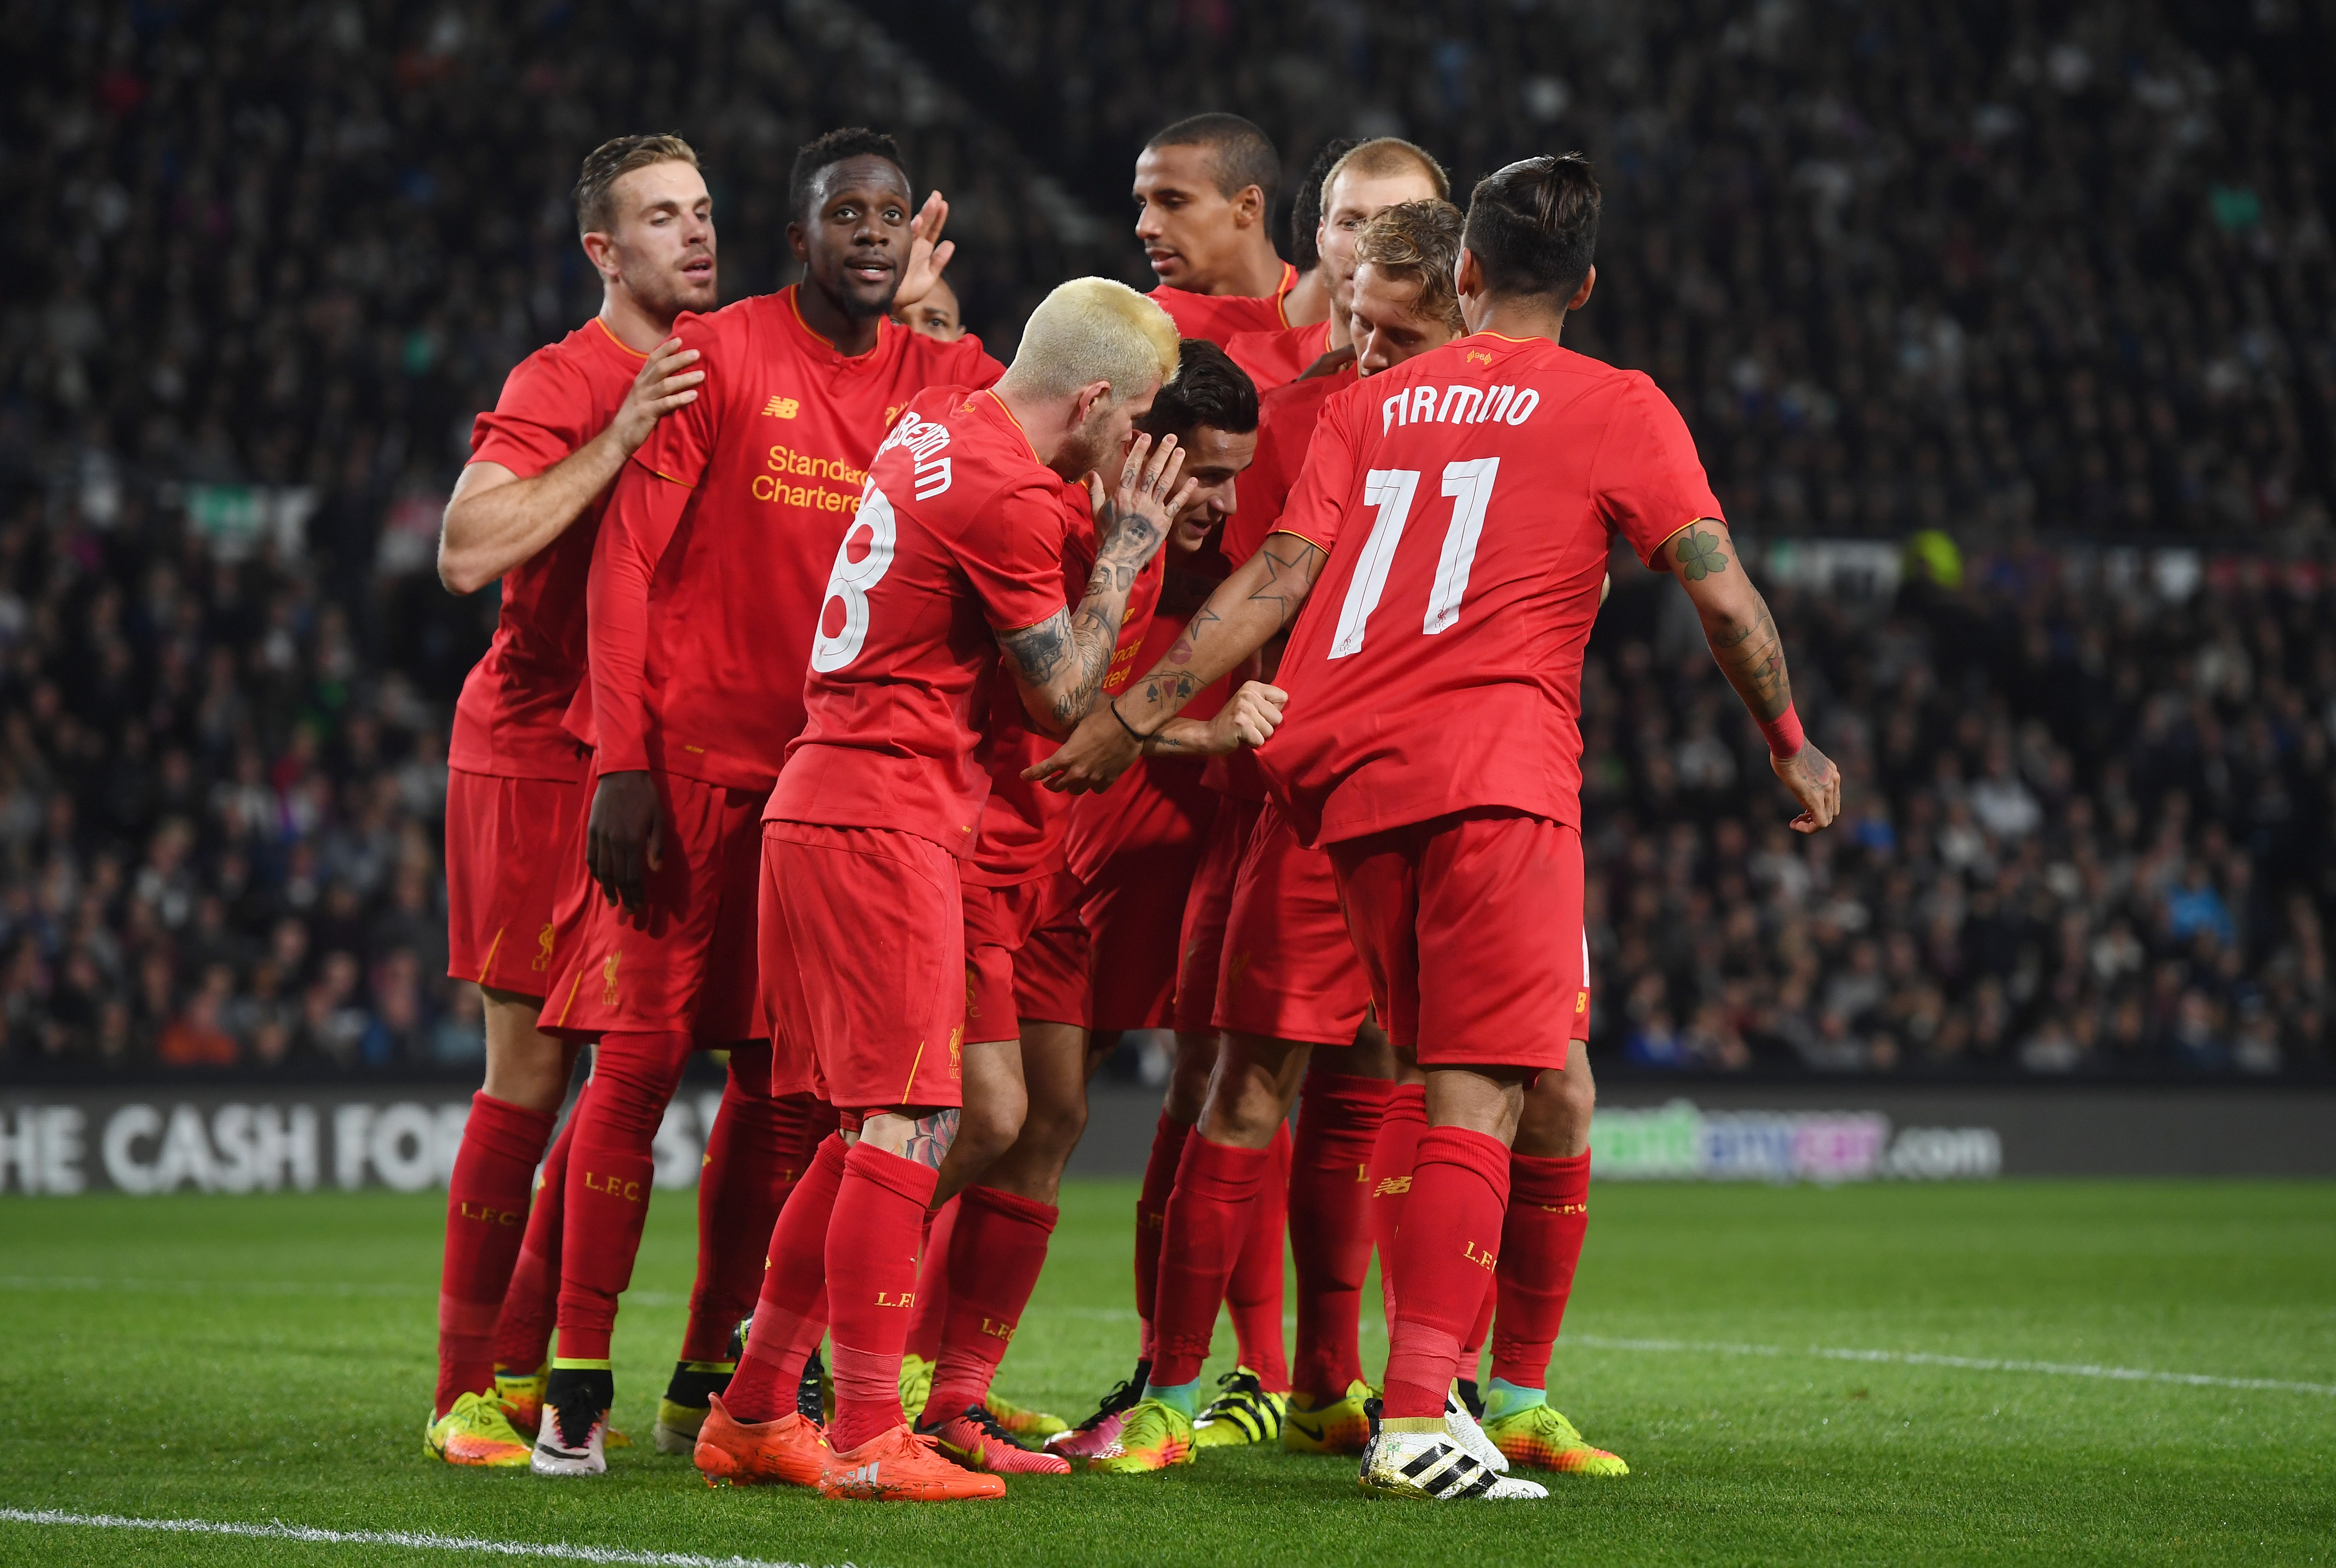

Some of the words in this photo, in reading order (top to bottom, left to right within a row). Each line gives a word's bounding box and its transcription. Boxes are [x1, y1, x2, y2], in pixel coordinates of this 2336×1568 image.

[1475, 352, 1485, 361] 96
[1382, 385, 1540, 438] FIRMINO
[752, 475, 862, 515] Chartere
[1327, 457, 1500, 659] 11
[0, 1103, 87, 1193] HE
[101, 1103, 319, 1195] CASH
